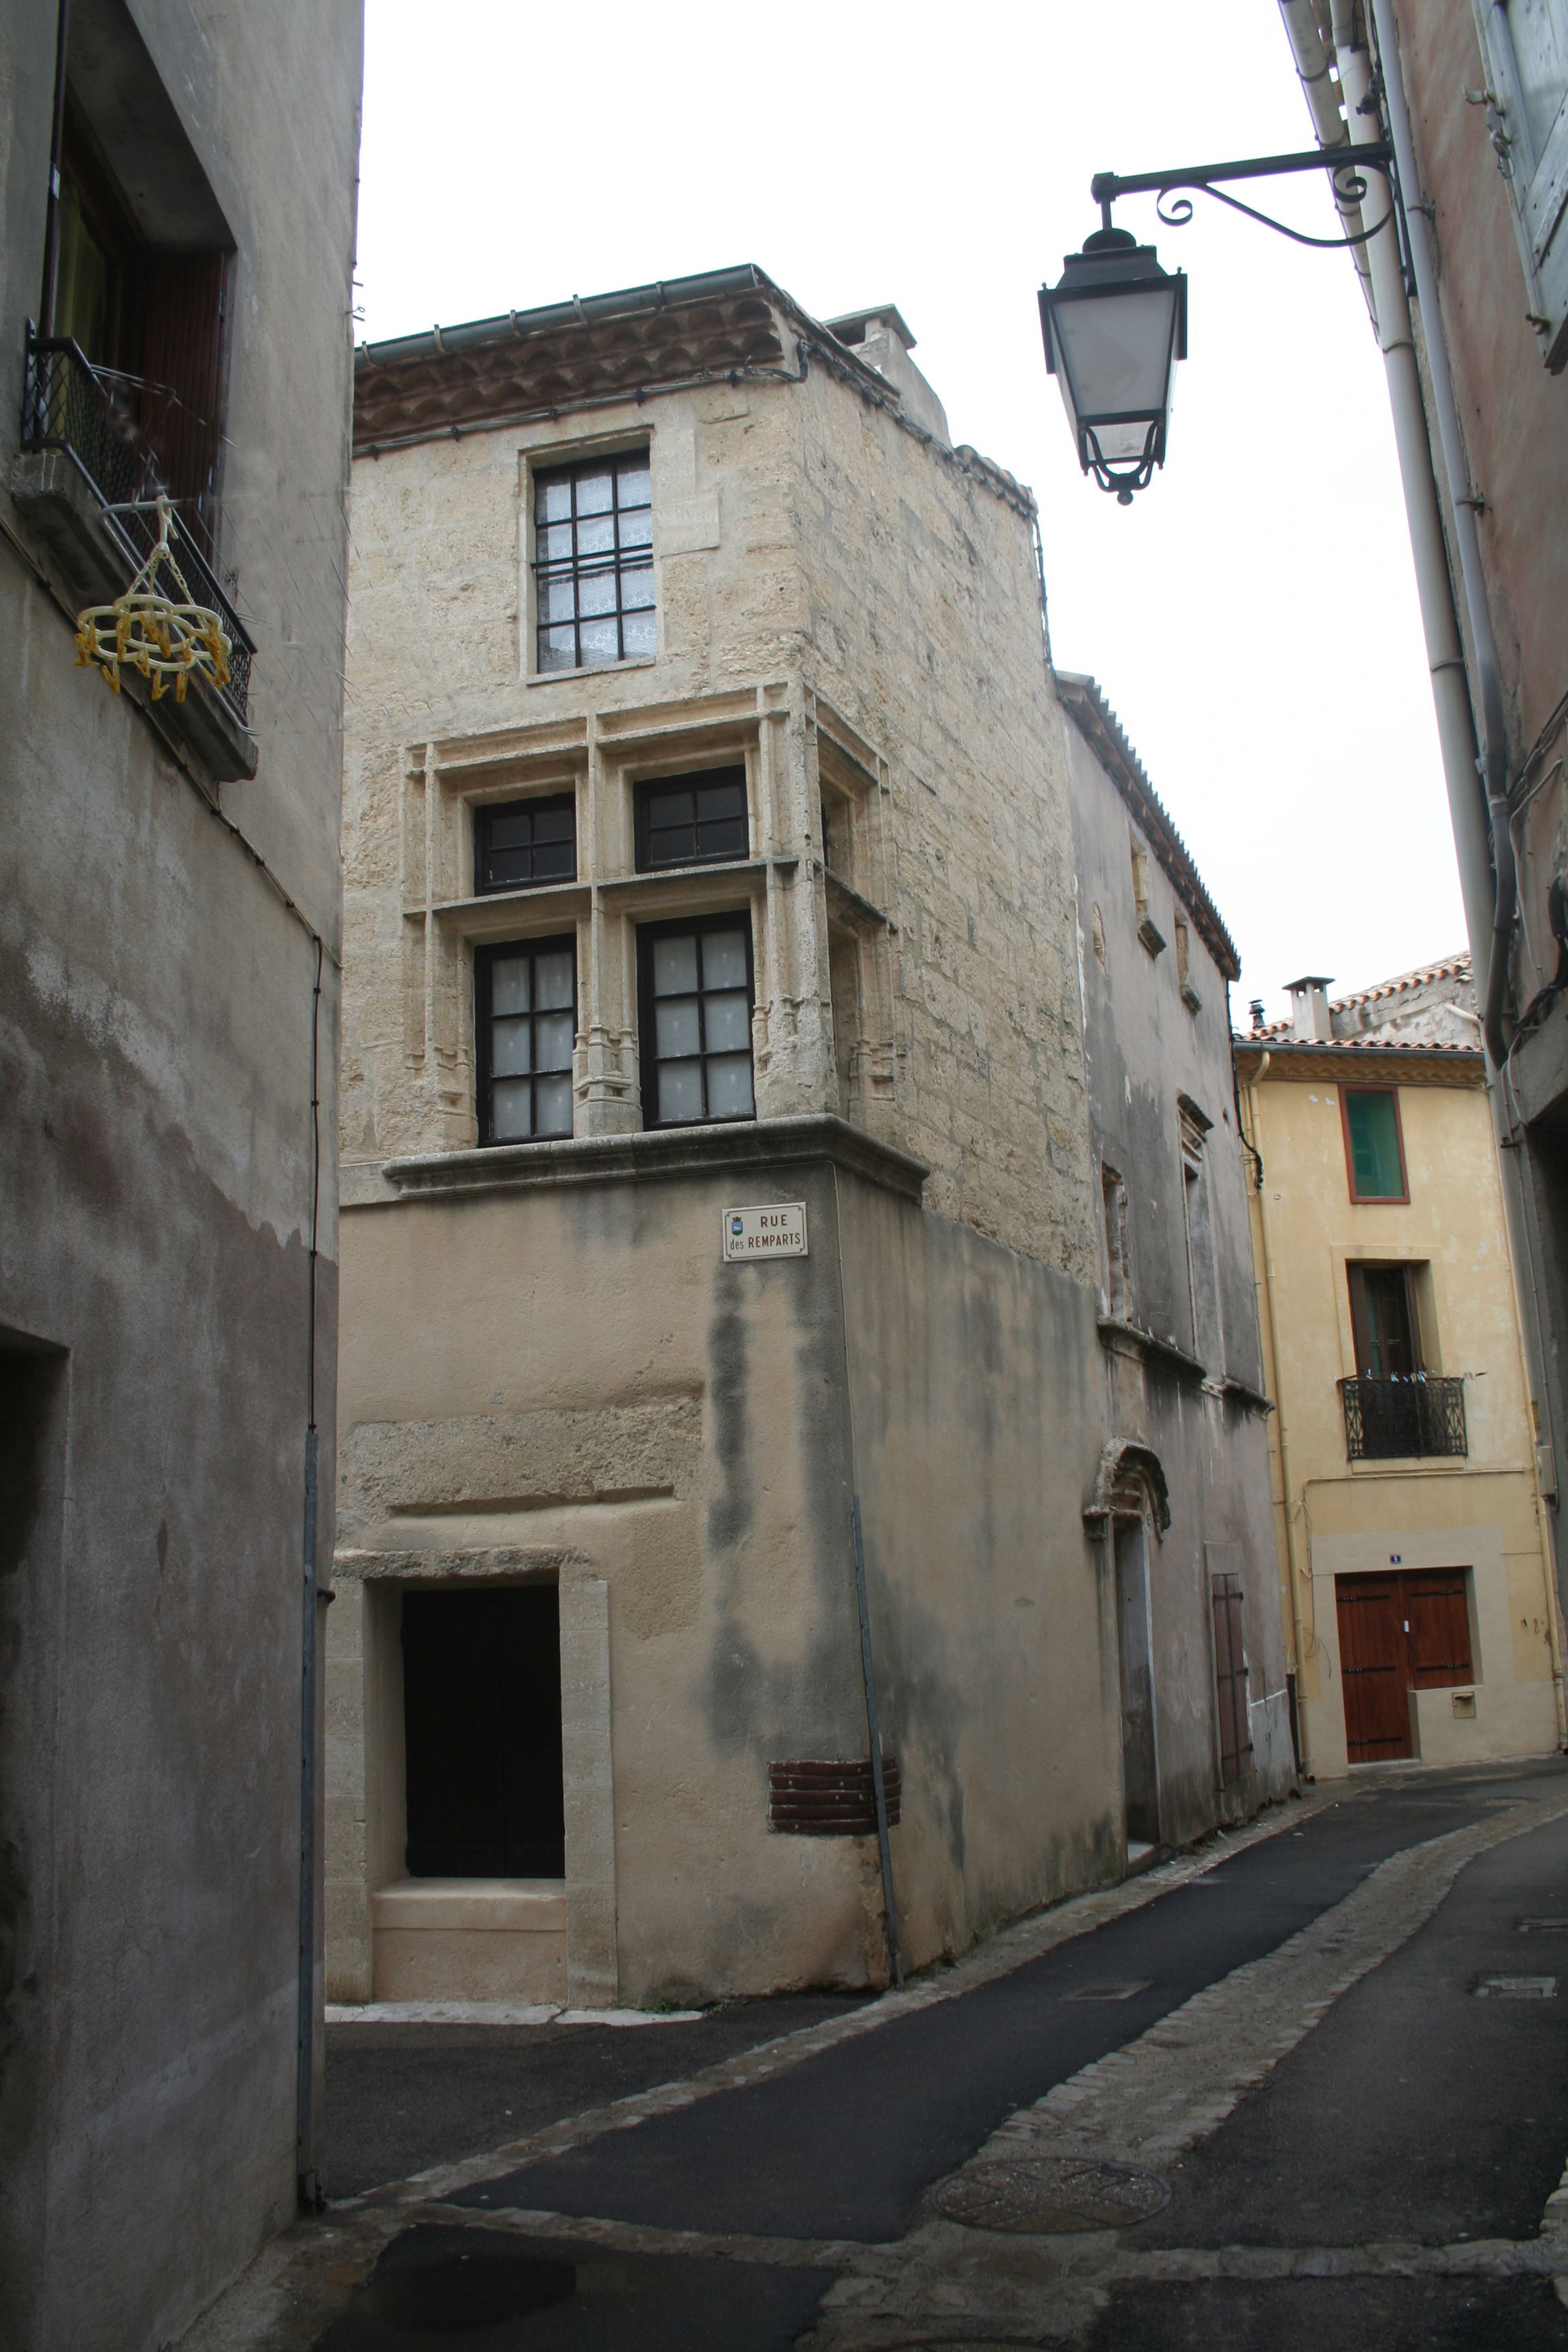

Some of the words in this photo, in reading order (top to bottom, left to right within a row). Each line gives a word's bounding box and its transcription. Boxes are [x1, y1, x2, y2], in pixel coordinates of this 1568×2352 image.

[760, 1214, 787, 1228] RUE
[730, 1239, 744, 1250] des
[749, 1232, 800, 1248] REMPARTS
